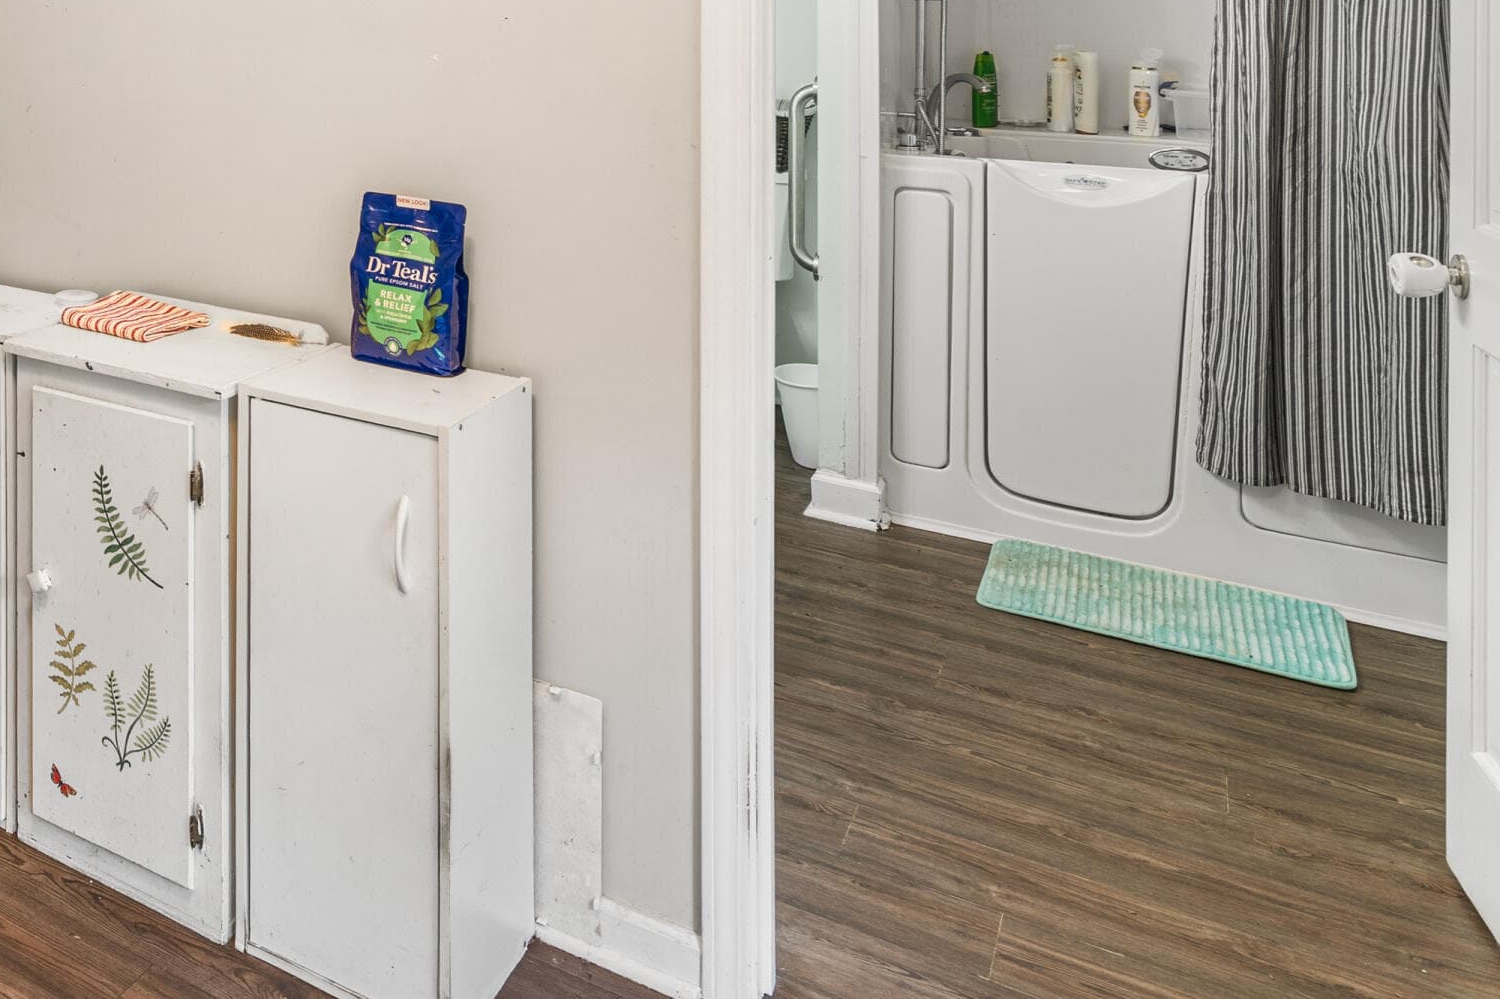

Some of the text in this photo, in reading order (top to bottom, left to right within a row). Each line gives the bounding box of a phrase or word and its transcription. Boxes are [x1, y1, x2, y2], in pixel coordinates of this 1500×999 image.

[366, 256, 390, 275] Dr
[392, 260, 437, 284] Teal's
[374, 275, 424, 290] PURE EPSOM SALT
[380, 289, 412, 303] RELAX
[374, 297, 416, 313] & RELIEF
